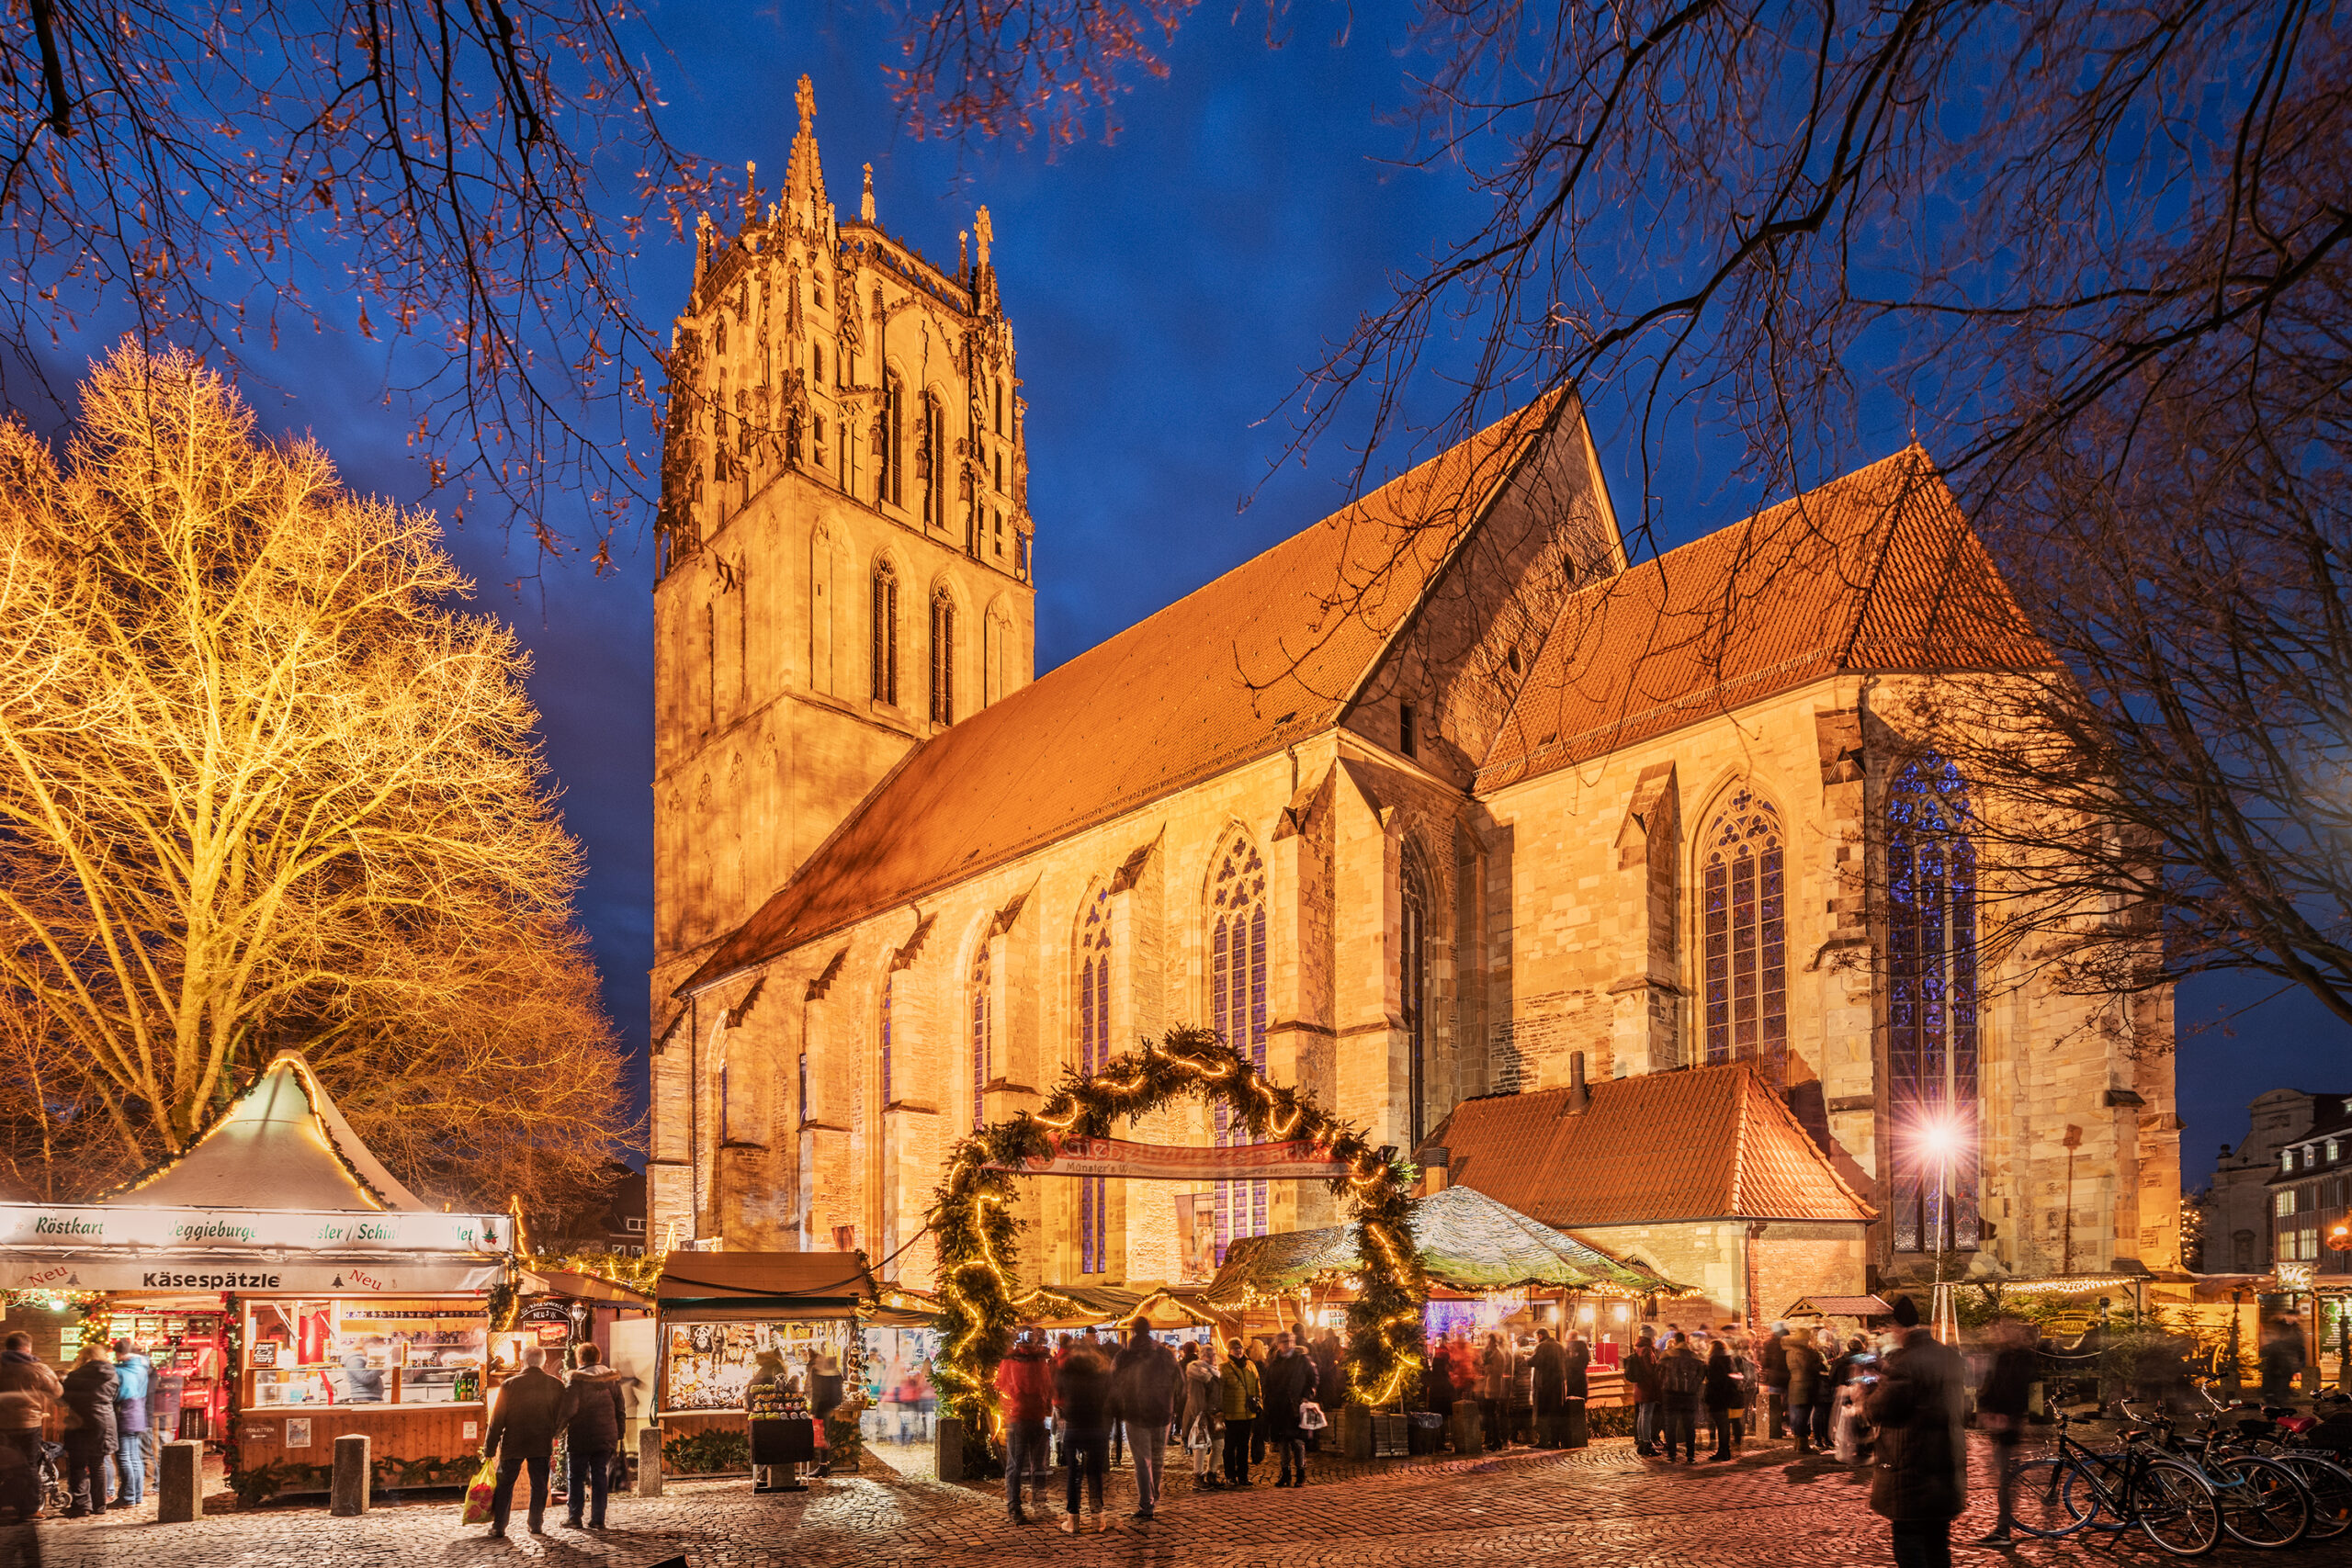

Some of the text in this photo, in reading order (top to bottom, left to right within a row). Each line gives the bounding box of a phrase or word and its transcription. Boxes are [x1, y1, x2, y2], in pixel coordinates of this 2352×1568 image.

[28, 1264, 69, 1287] Neu
[143, 1272, 280, 1290] Käsespätzle
[349, 1269, 382, 1292] Neu
[2278, 1268, 2310, 1282] WC
